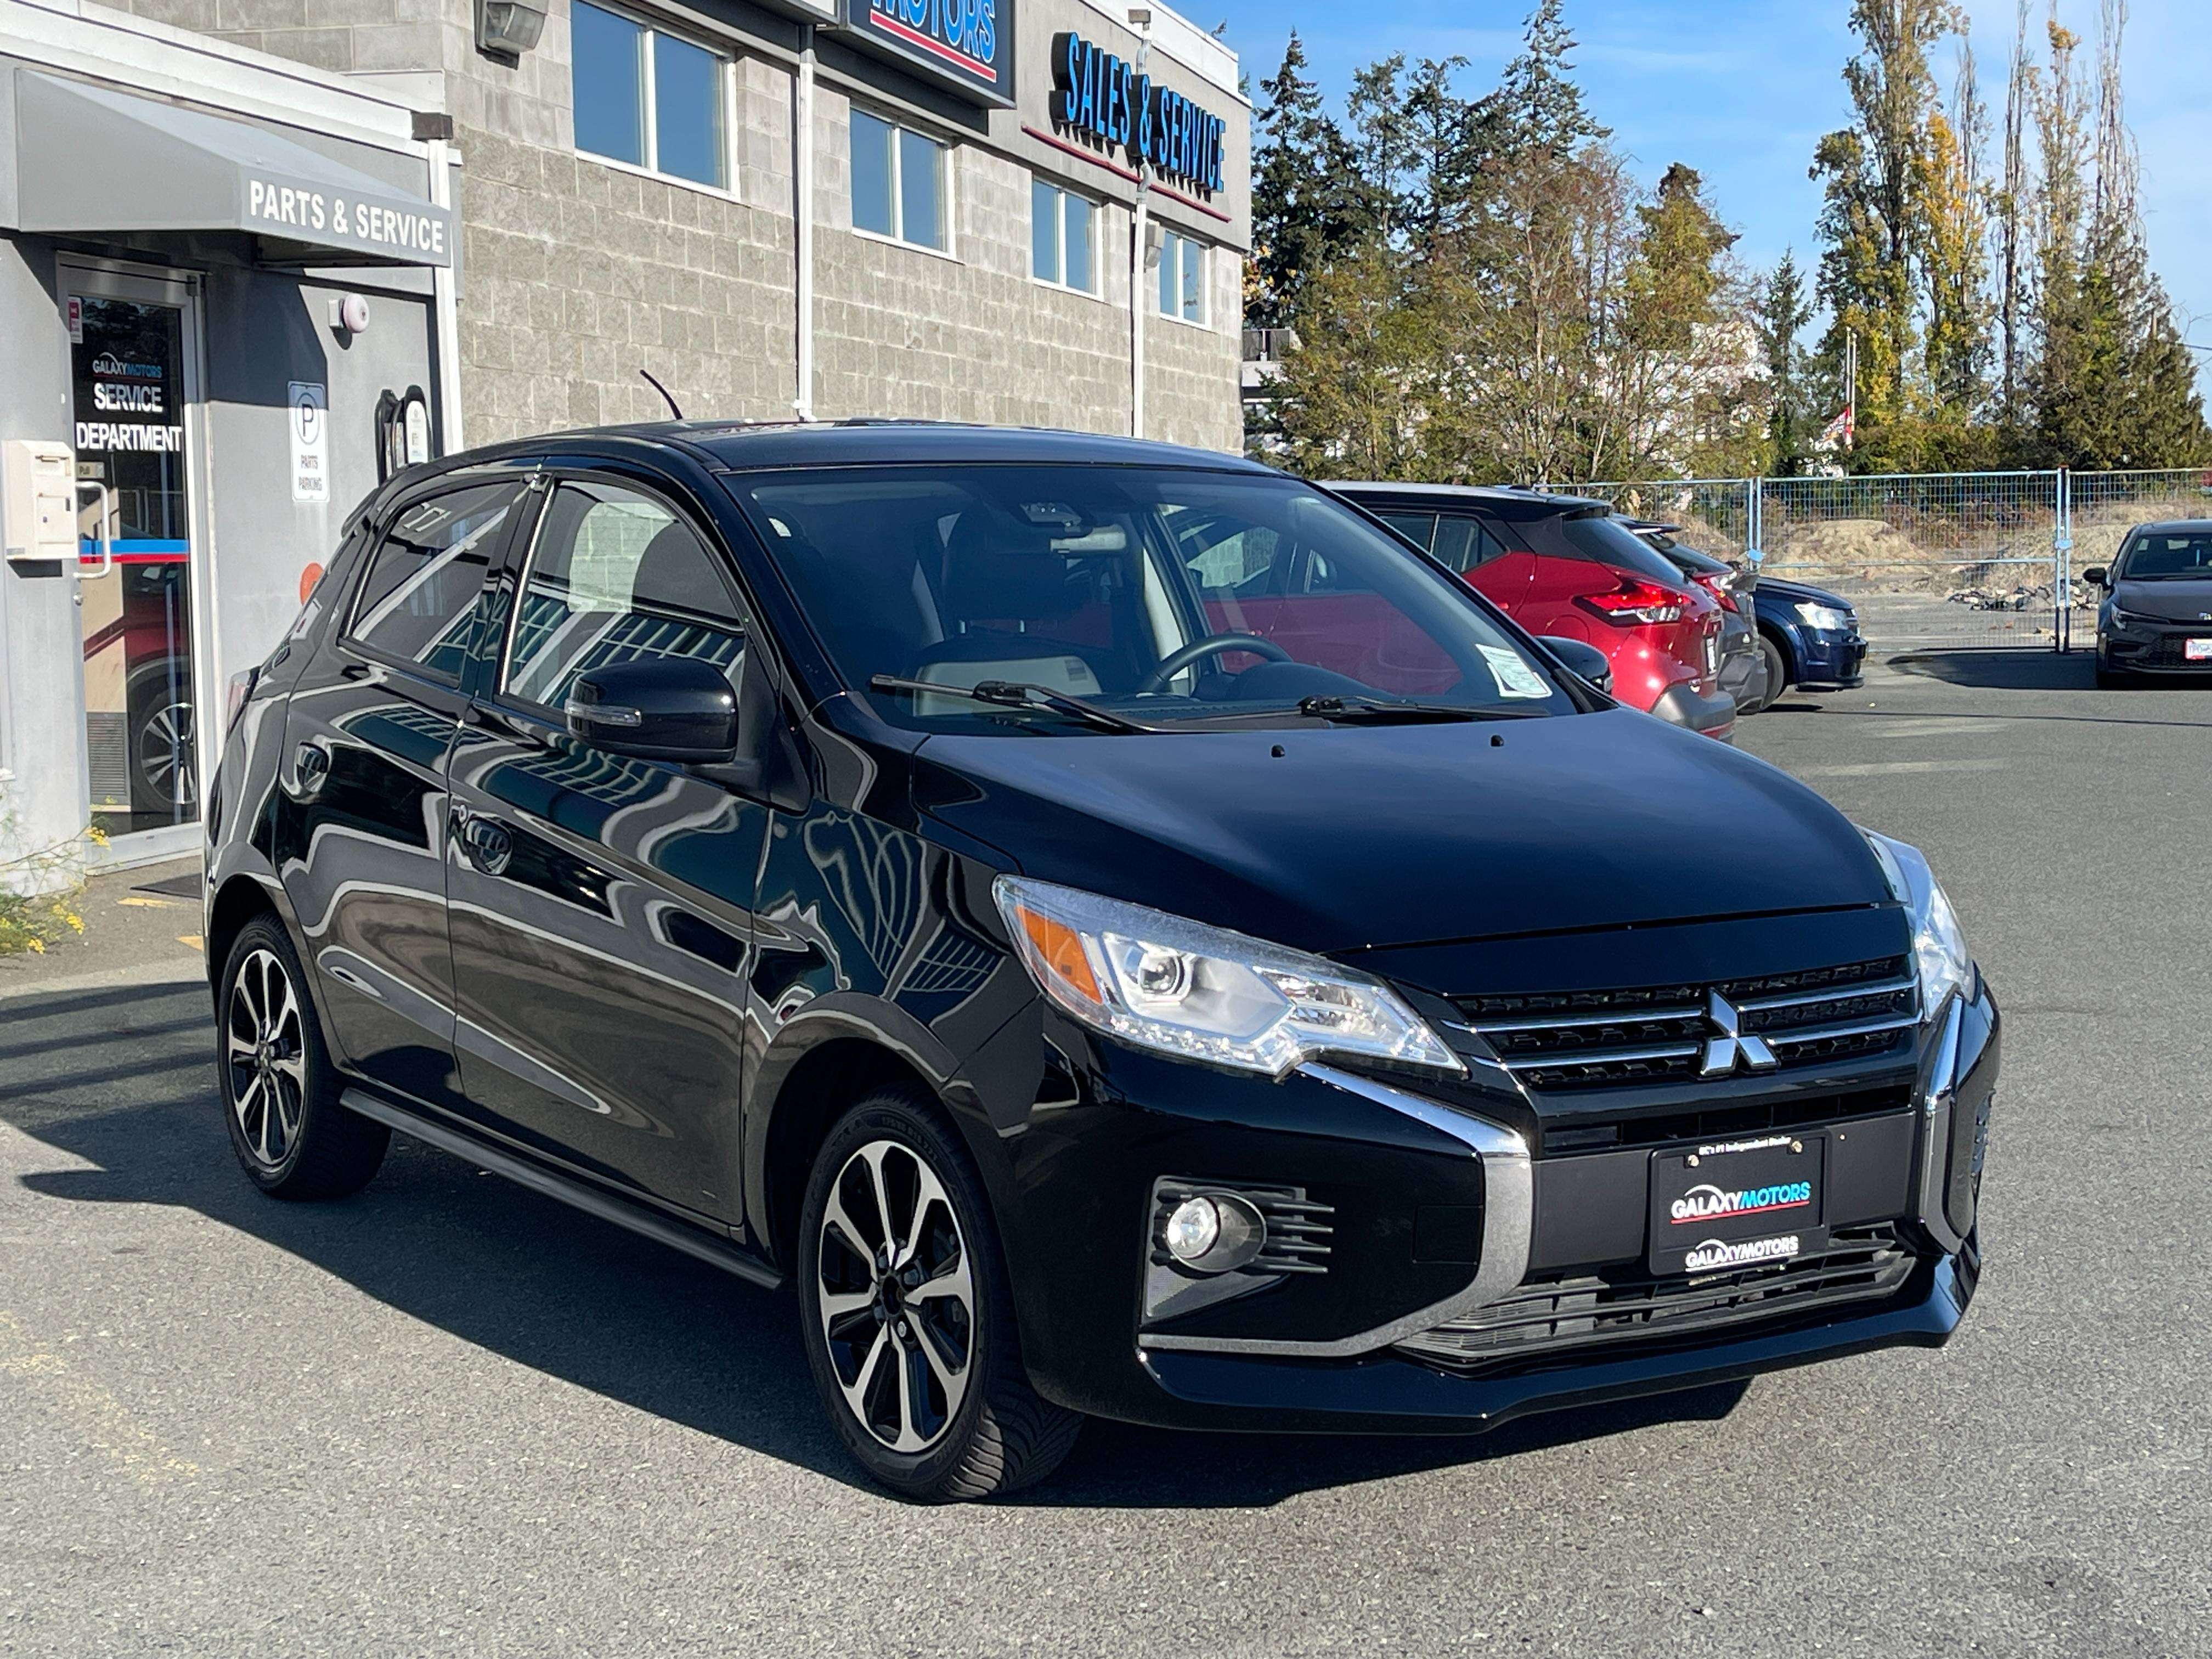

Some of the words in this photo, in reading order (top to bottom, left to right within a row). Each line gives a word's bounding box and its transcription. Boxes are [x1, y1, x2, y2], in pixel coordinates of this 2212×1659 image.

[872, 0, 996, 64] TORS
[1063, 32, 1132, 146] SALES
[1158, 86, 1226, 194] SERVICE
[250, 179, 325, 230] PARTS
[332, 199, 349, 235] &
[356, 204, 444, 254] SERVICE
[94, 382, 163, 413] SERVICE
[302, 403, 314, 437] P
[76, 421, 182, 452] DEPARTMENT
